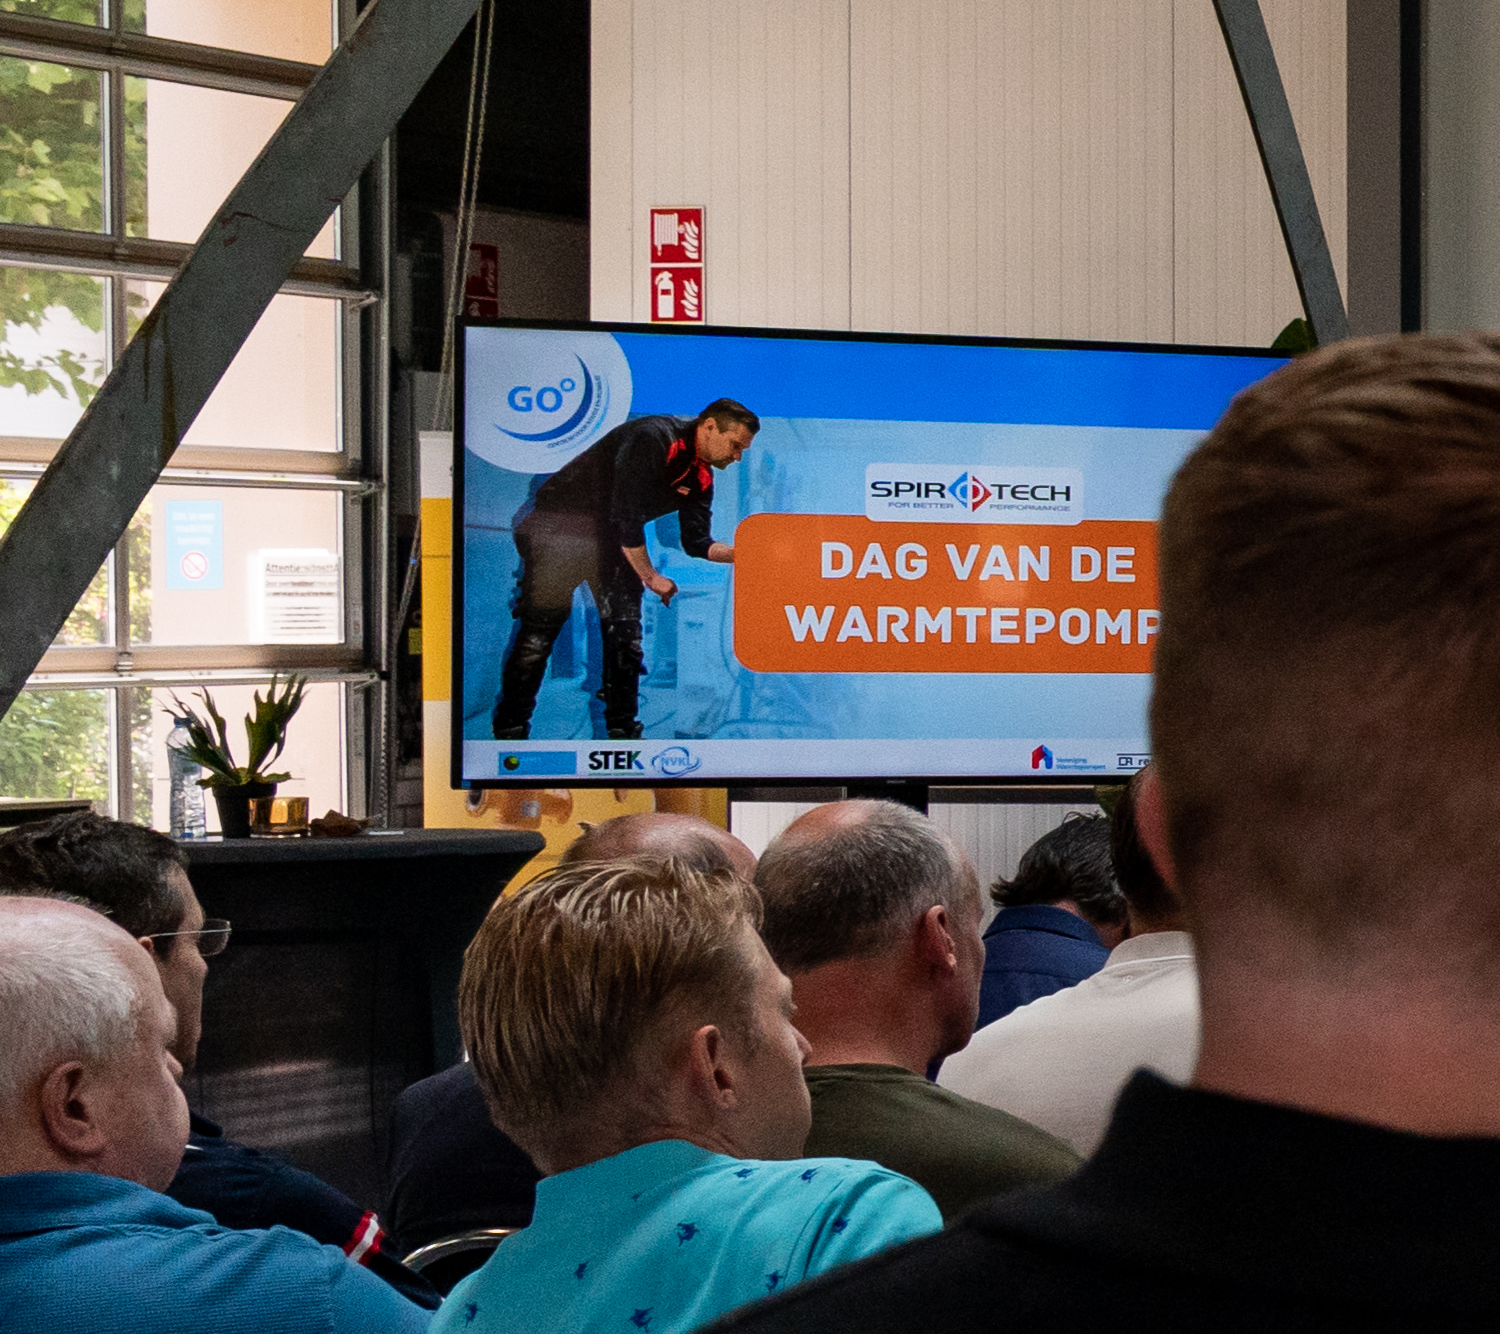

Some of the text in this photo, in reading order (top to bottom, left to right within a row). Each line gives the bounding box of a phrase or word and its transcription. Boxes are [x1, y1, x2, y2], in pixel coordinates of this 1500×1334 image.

[821, 541, 1136, 582] DAG VAN DE
[784, 605, 1163, 645] WARMTEPOMP
[588, 750, 645, 770] STEK
